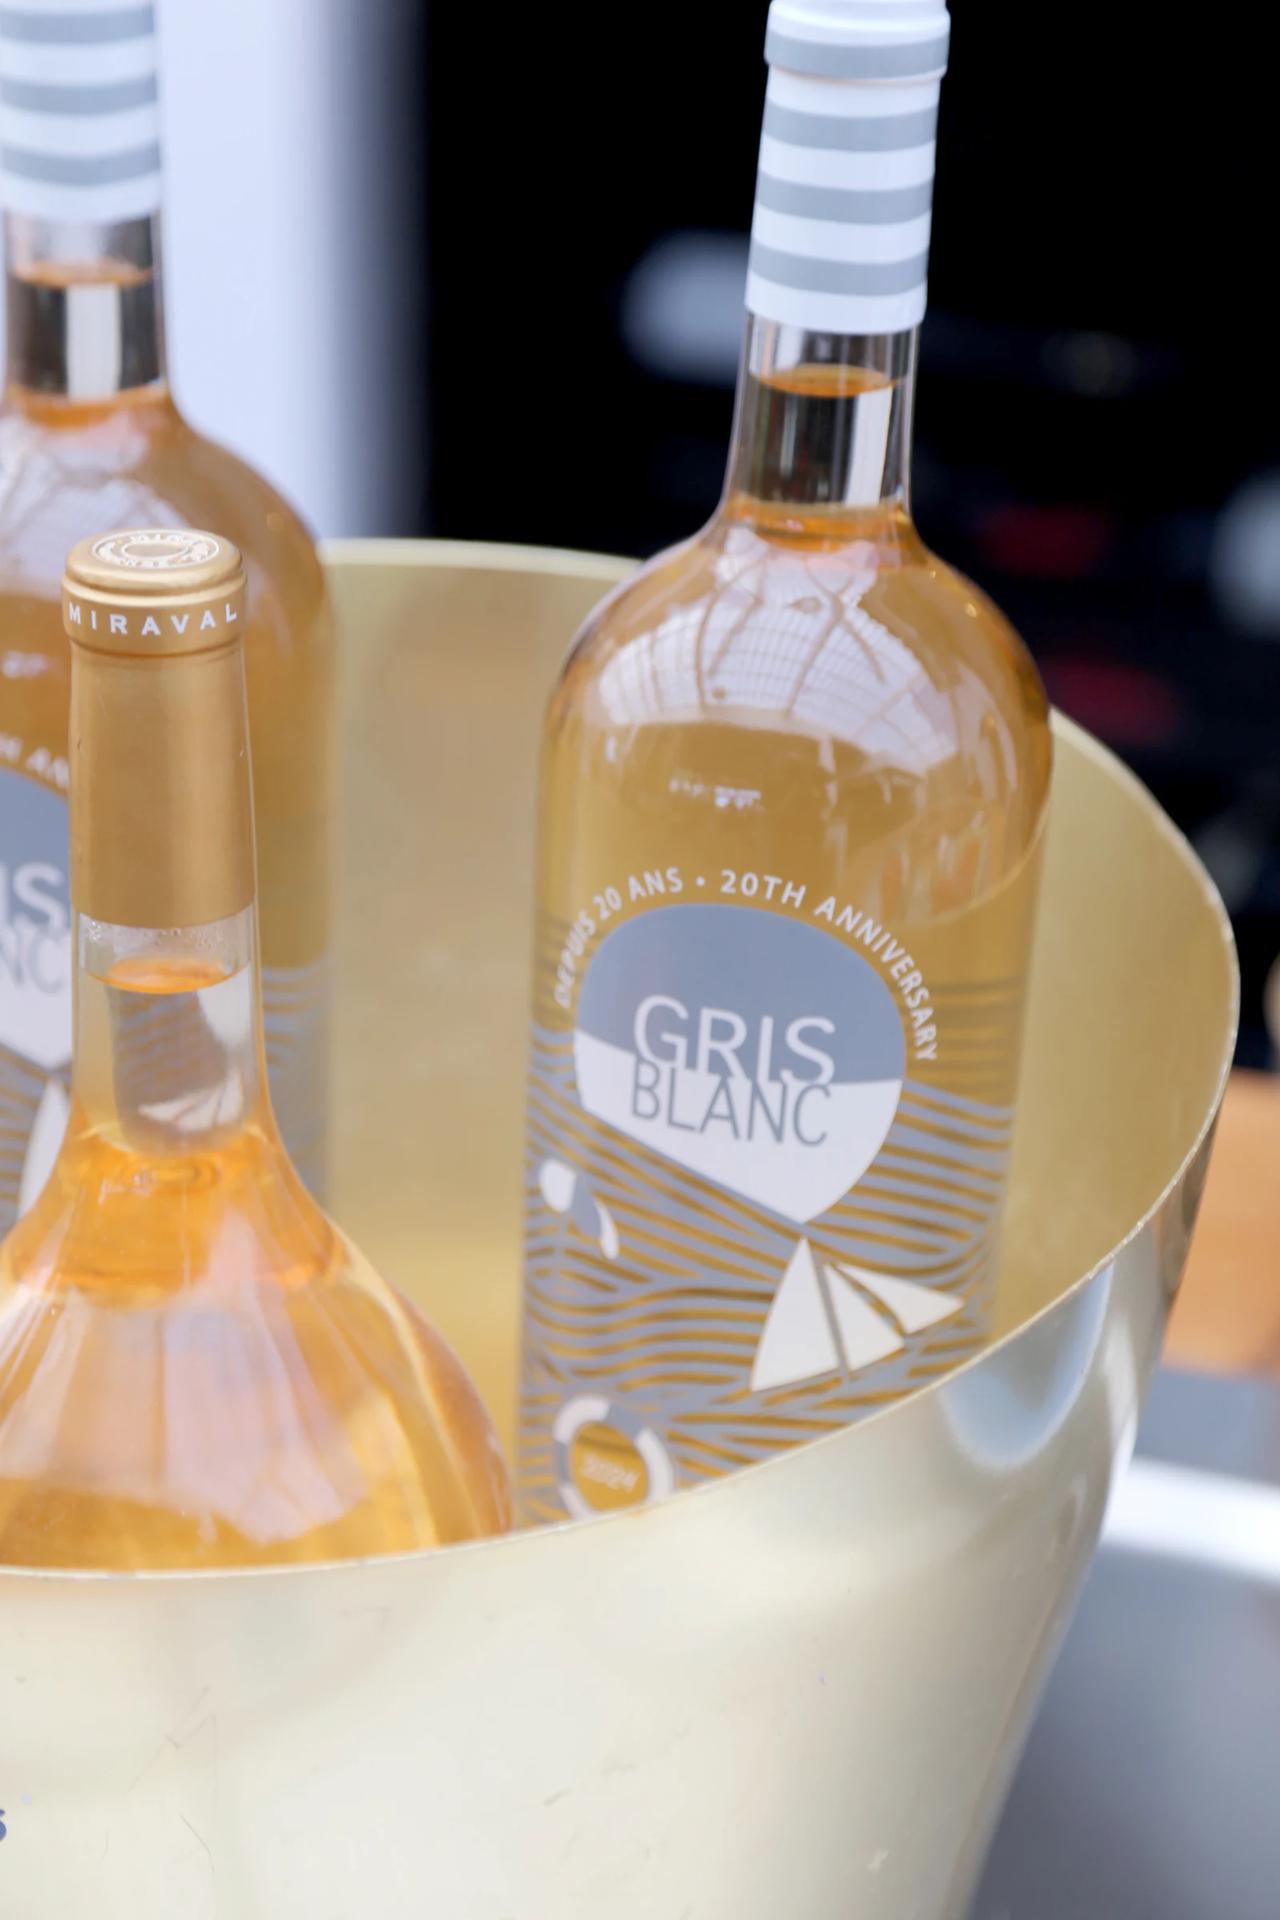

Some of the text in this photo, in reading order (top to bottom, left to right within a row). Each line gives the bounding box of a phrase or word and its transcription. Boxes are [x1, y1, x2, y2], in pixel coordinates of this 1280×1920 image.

[68, 601, 238, 636] MIRAVAL
[0, 860, 66, 938] IS
[554, 866, 938, 1061] DEPUIS 20 ANS 20TH ANNIVERSARY
[633, 994, 836, 1086] GRIS
[632, 1056, 832, 1147] BLANC
